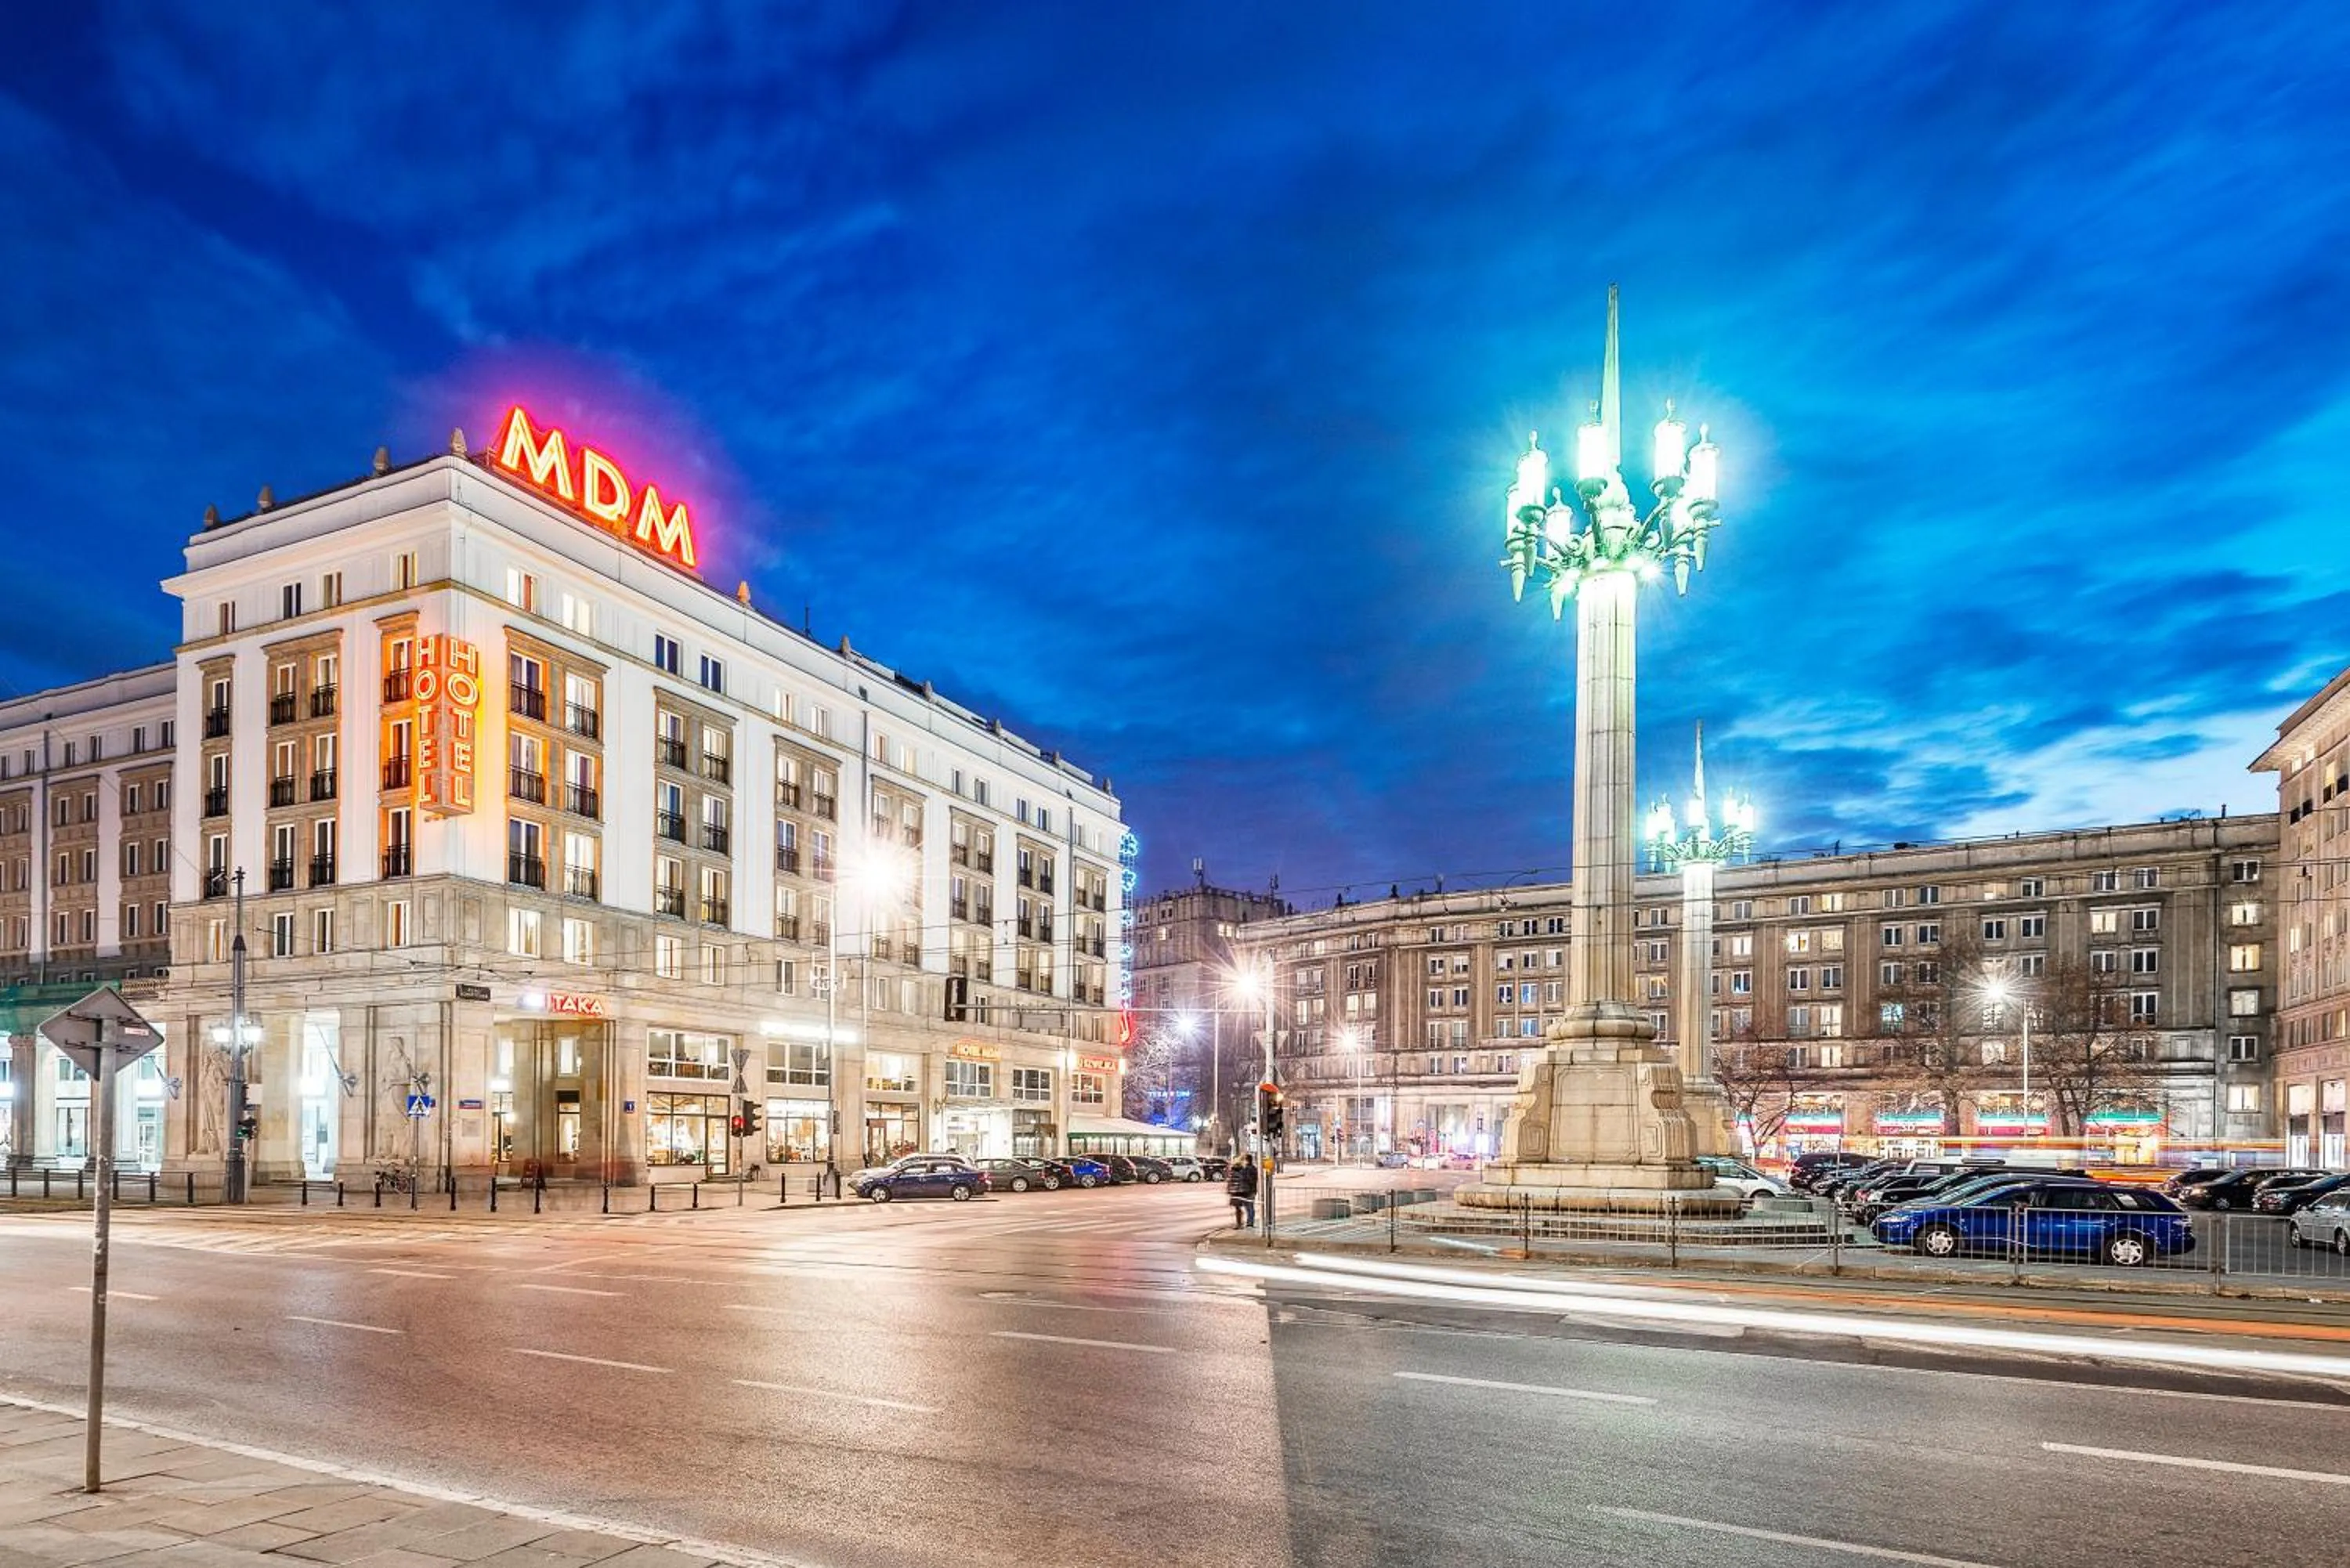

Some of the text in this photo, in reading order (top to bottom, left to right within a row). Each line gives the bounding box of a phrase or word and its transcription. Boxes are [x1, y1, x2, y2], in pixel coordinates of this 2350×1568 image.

[499, 406, 696, 568] MDM
[414, 636, 436, 803] HOTEL
[447, 638, 479, 807] HOTEL
